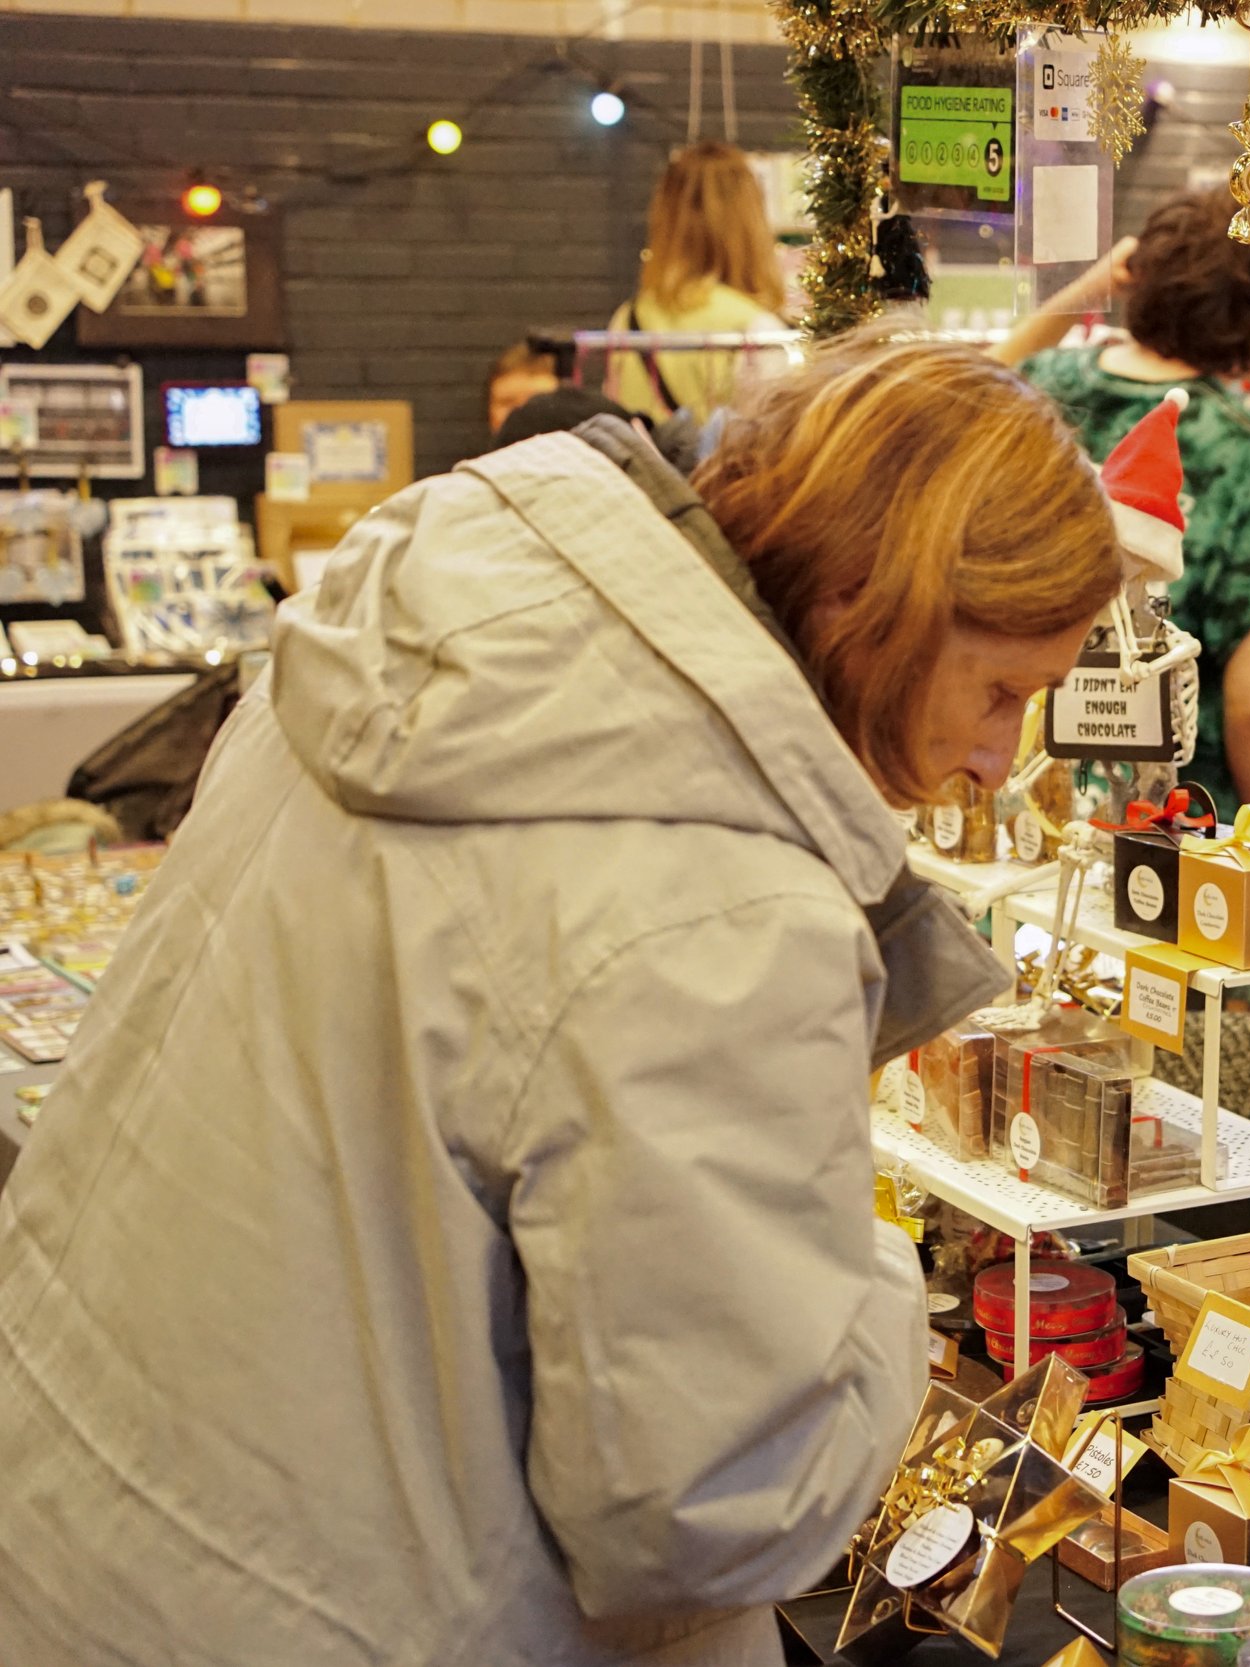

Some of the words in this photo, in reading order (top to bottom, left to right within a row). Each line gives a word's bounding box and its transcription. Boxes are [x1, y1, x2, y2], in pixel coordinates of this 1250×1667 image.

[1057, 69, 1090, 87] Square
[907, 95, 932, 111] FOOD
[933, 96, 971, 112] HYGIENE
[972, 98, 1005, 113] RATING
[988, 142, 1000, 172] 5
[1074, 678, 1080, 692] I
[1083, 677, 1116, 692] DIDN'T
[1085, 701, 1127, 715] ENOUGH
[1077, 723, 1137, 738] CHOCOLATE
[1087, 1444, 1114, 1467] Pistoles
[1075, 1460, 1102, 1478] £7.50
